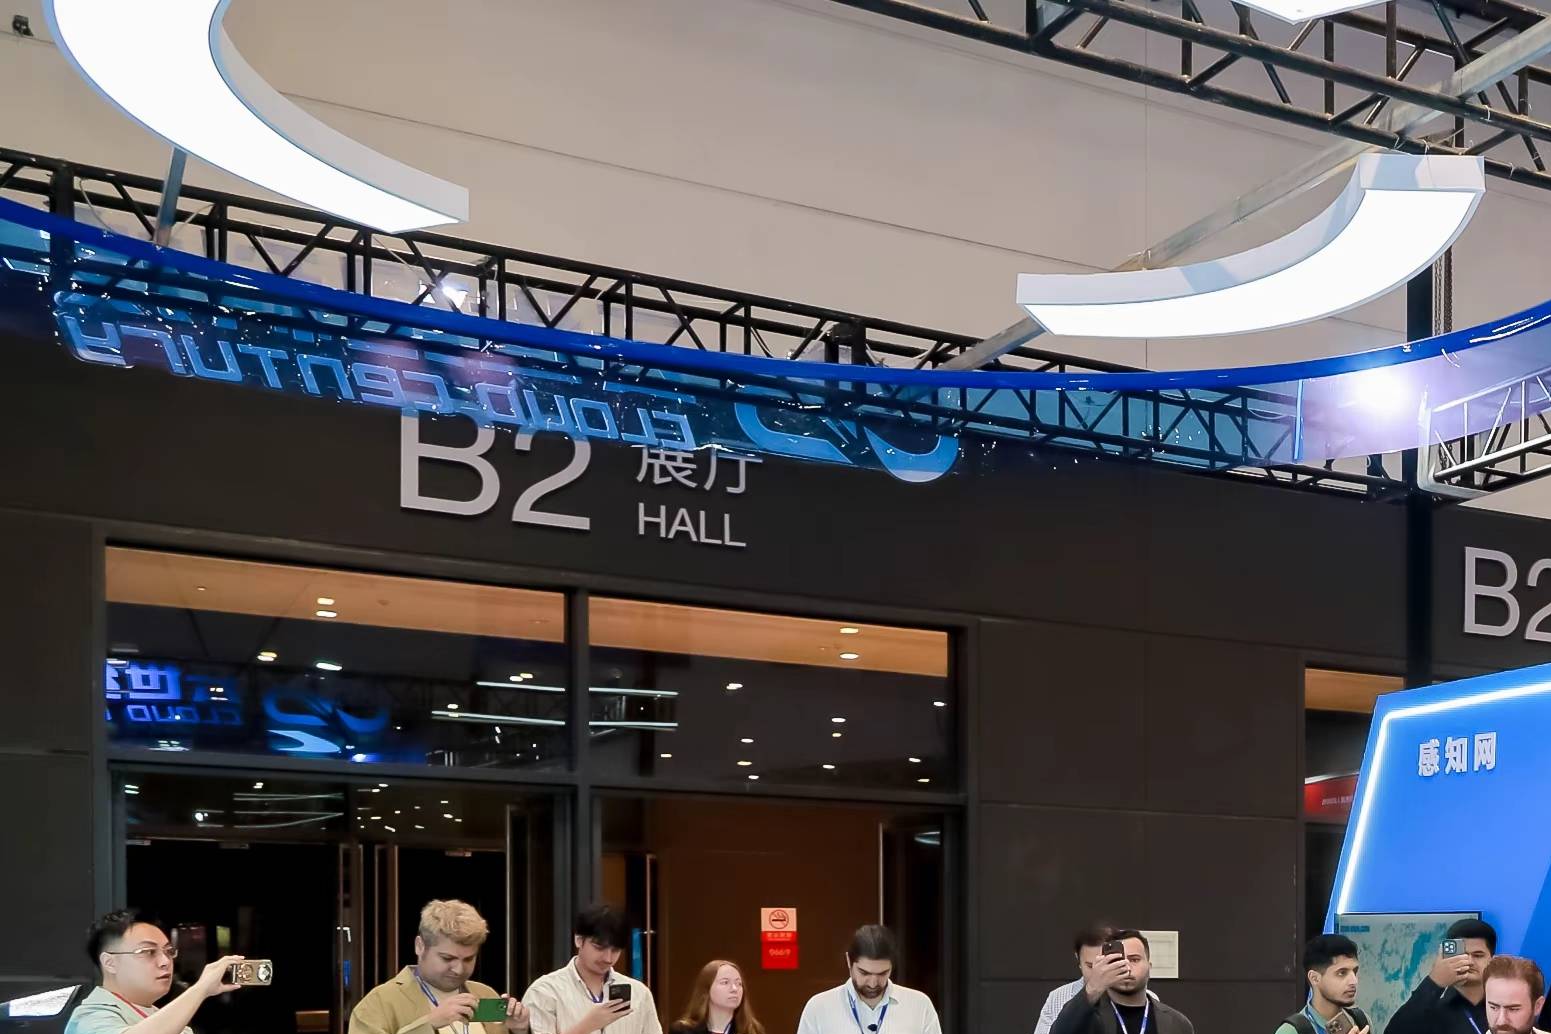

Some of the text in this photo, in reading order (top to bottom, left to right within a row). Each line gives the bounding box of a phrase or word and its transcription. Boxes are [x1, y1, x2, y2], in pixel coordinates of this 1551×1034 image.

[400, 400, 592, 531] B2
[635, 444, 764, 494] 展厅
[637, 501, 747, 548] HALL
[1417, 730, 1498, 778] 感知网
